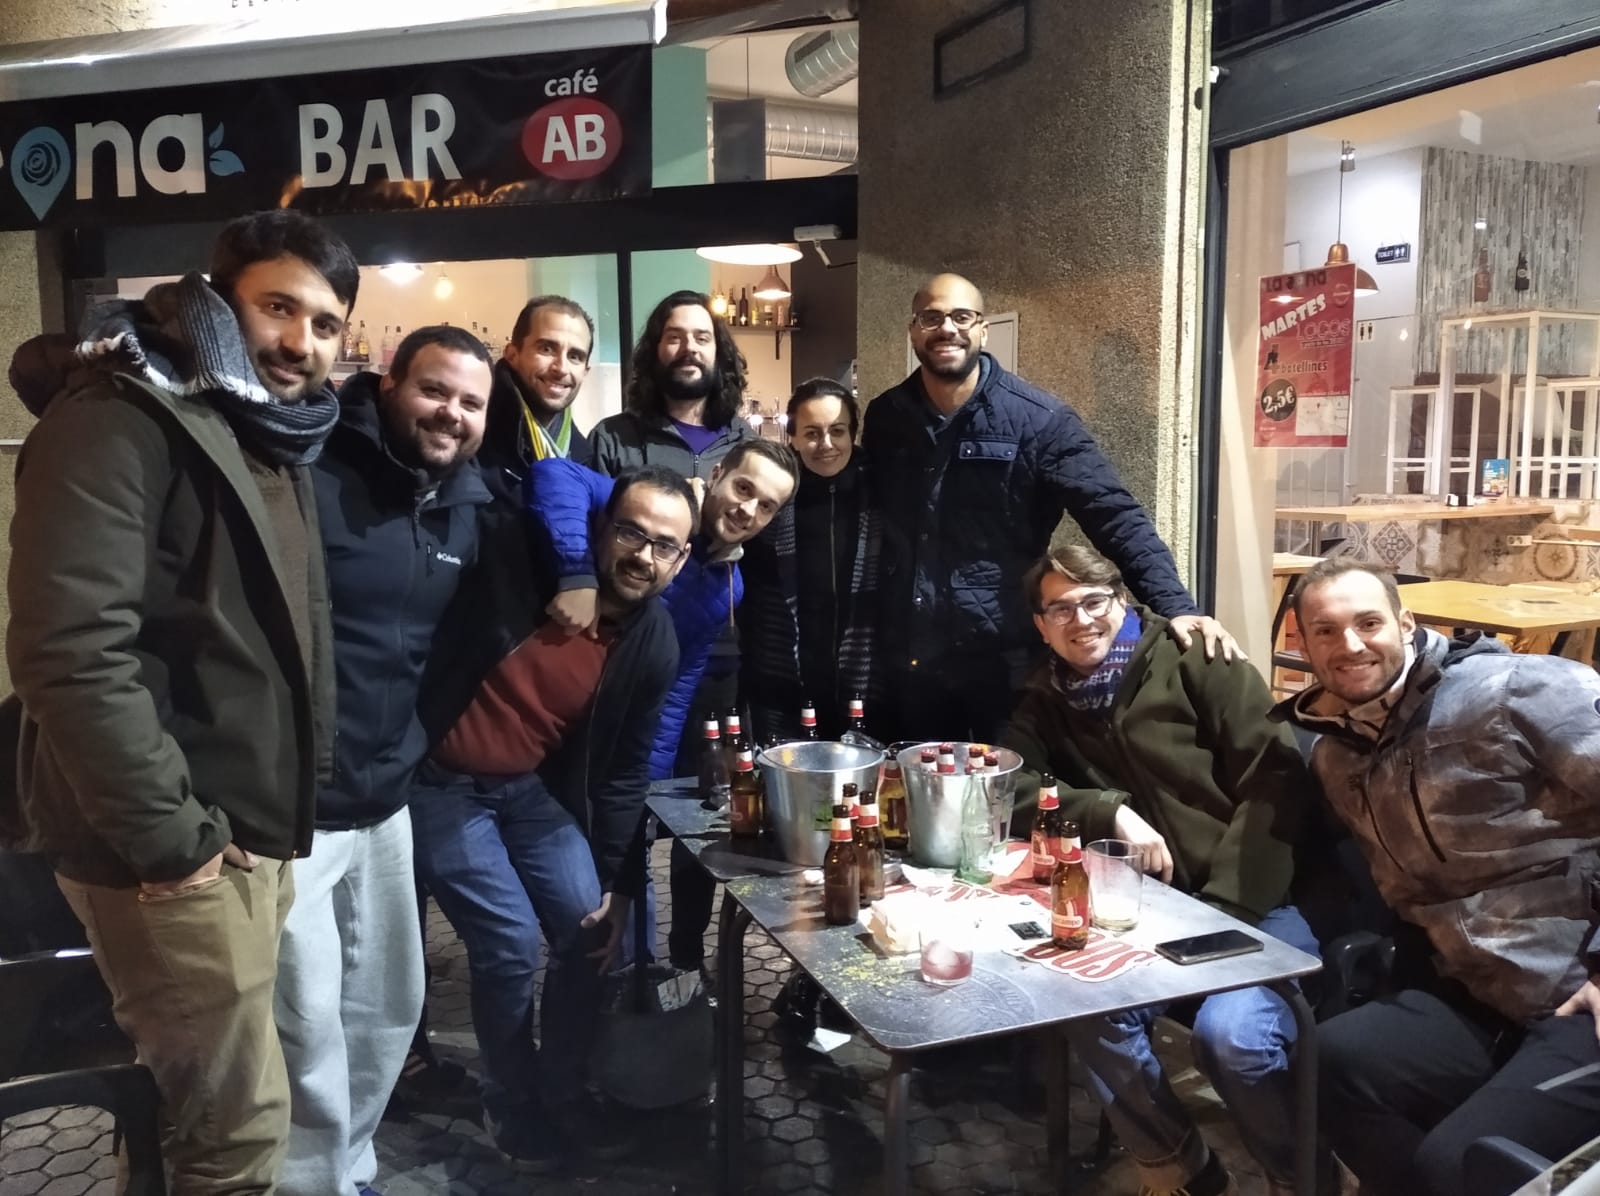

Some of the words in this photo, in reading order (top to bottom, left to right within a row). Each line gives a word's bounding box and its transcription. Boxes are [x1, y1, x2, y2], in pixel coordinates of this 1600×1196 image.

[544, 69, 598, 97] café
[299, 93, 461, 188] BAR
[542, 113, 607, 164] AB
[1261, 293, 1327, 341] MARTES
[1296, 318, 1351, 341] LOCOS
[1263, 386, 1295, 414] 2,5€
